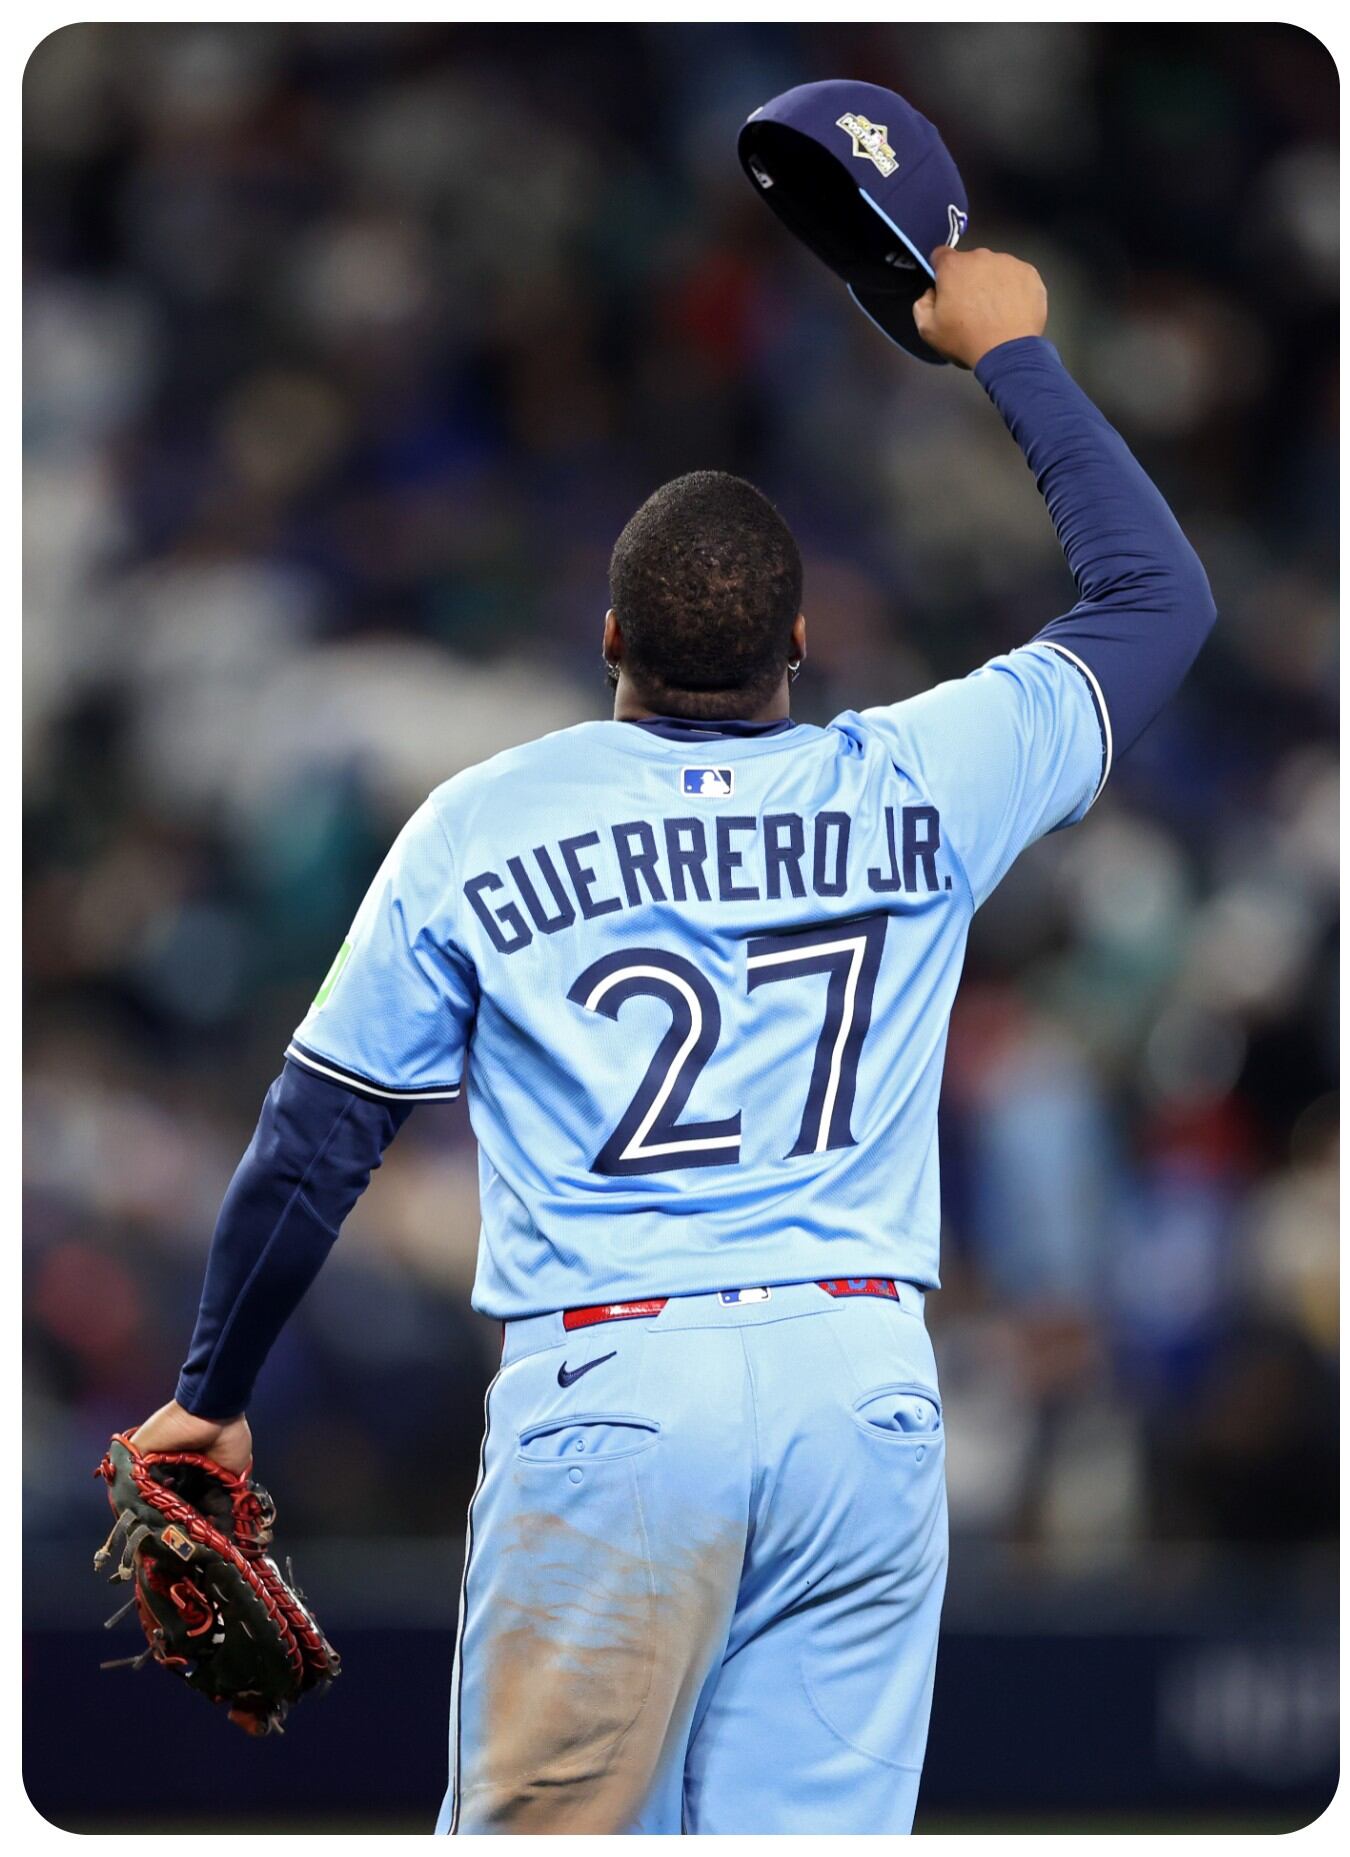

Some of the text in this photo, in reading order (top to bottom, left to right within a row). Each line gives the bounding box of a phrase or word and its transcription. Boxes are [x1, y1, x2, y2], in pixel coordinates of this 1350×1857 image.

[463, 806, 952, 955] GUERRERO JR.
[567, 911, 889, 1177] 27
